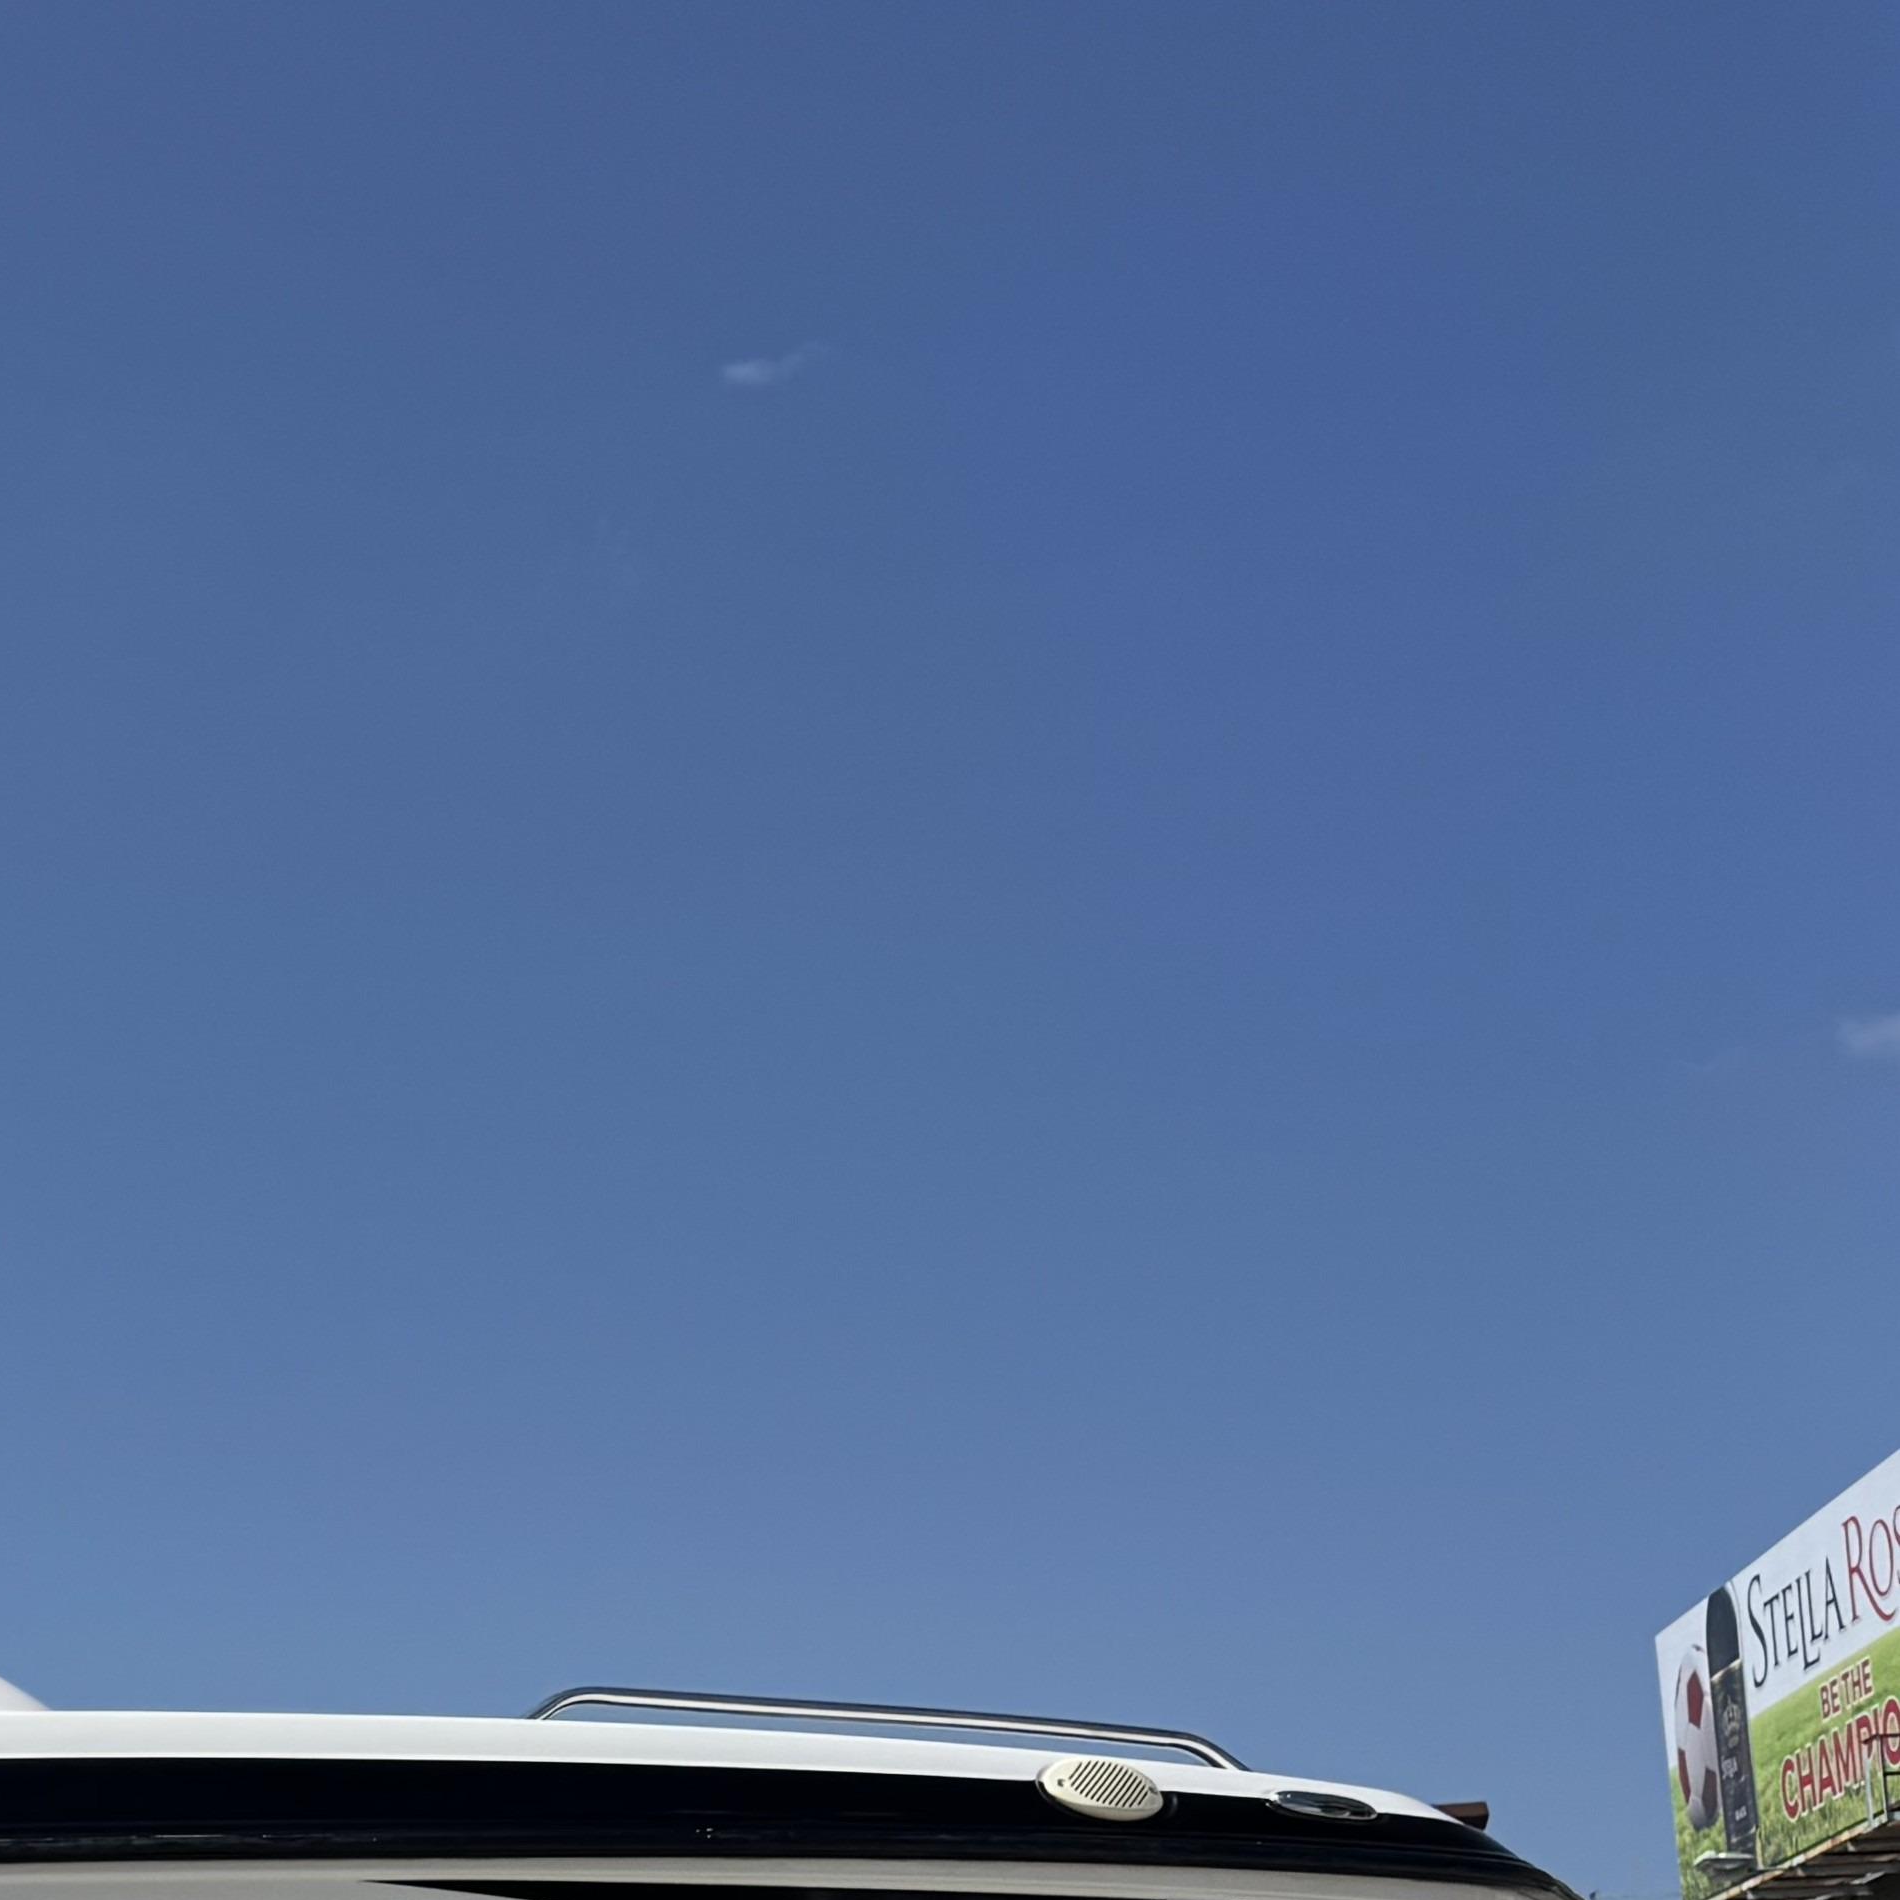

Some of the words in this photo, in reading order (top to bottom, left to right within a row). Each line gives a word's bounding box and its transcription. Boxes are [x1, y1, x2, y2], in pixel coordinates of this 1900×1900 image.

[1747, 1556, 1846, 1688] STELLA
[1820, 1672, 1842, 1721] BE
[1842, 1656, 1874, 1708] THE
